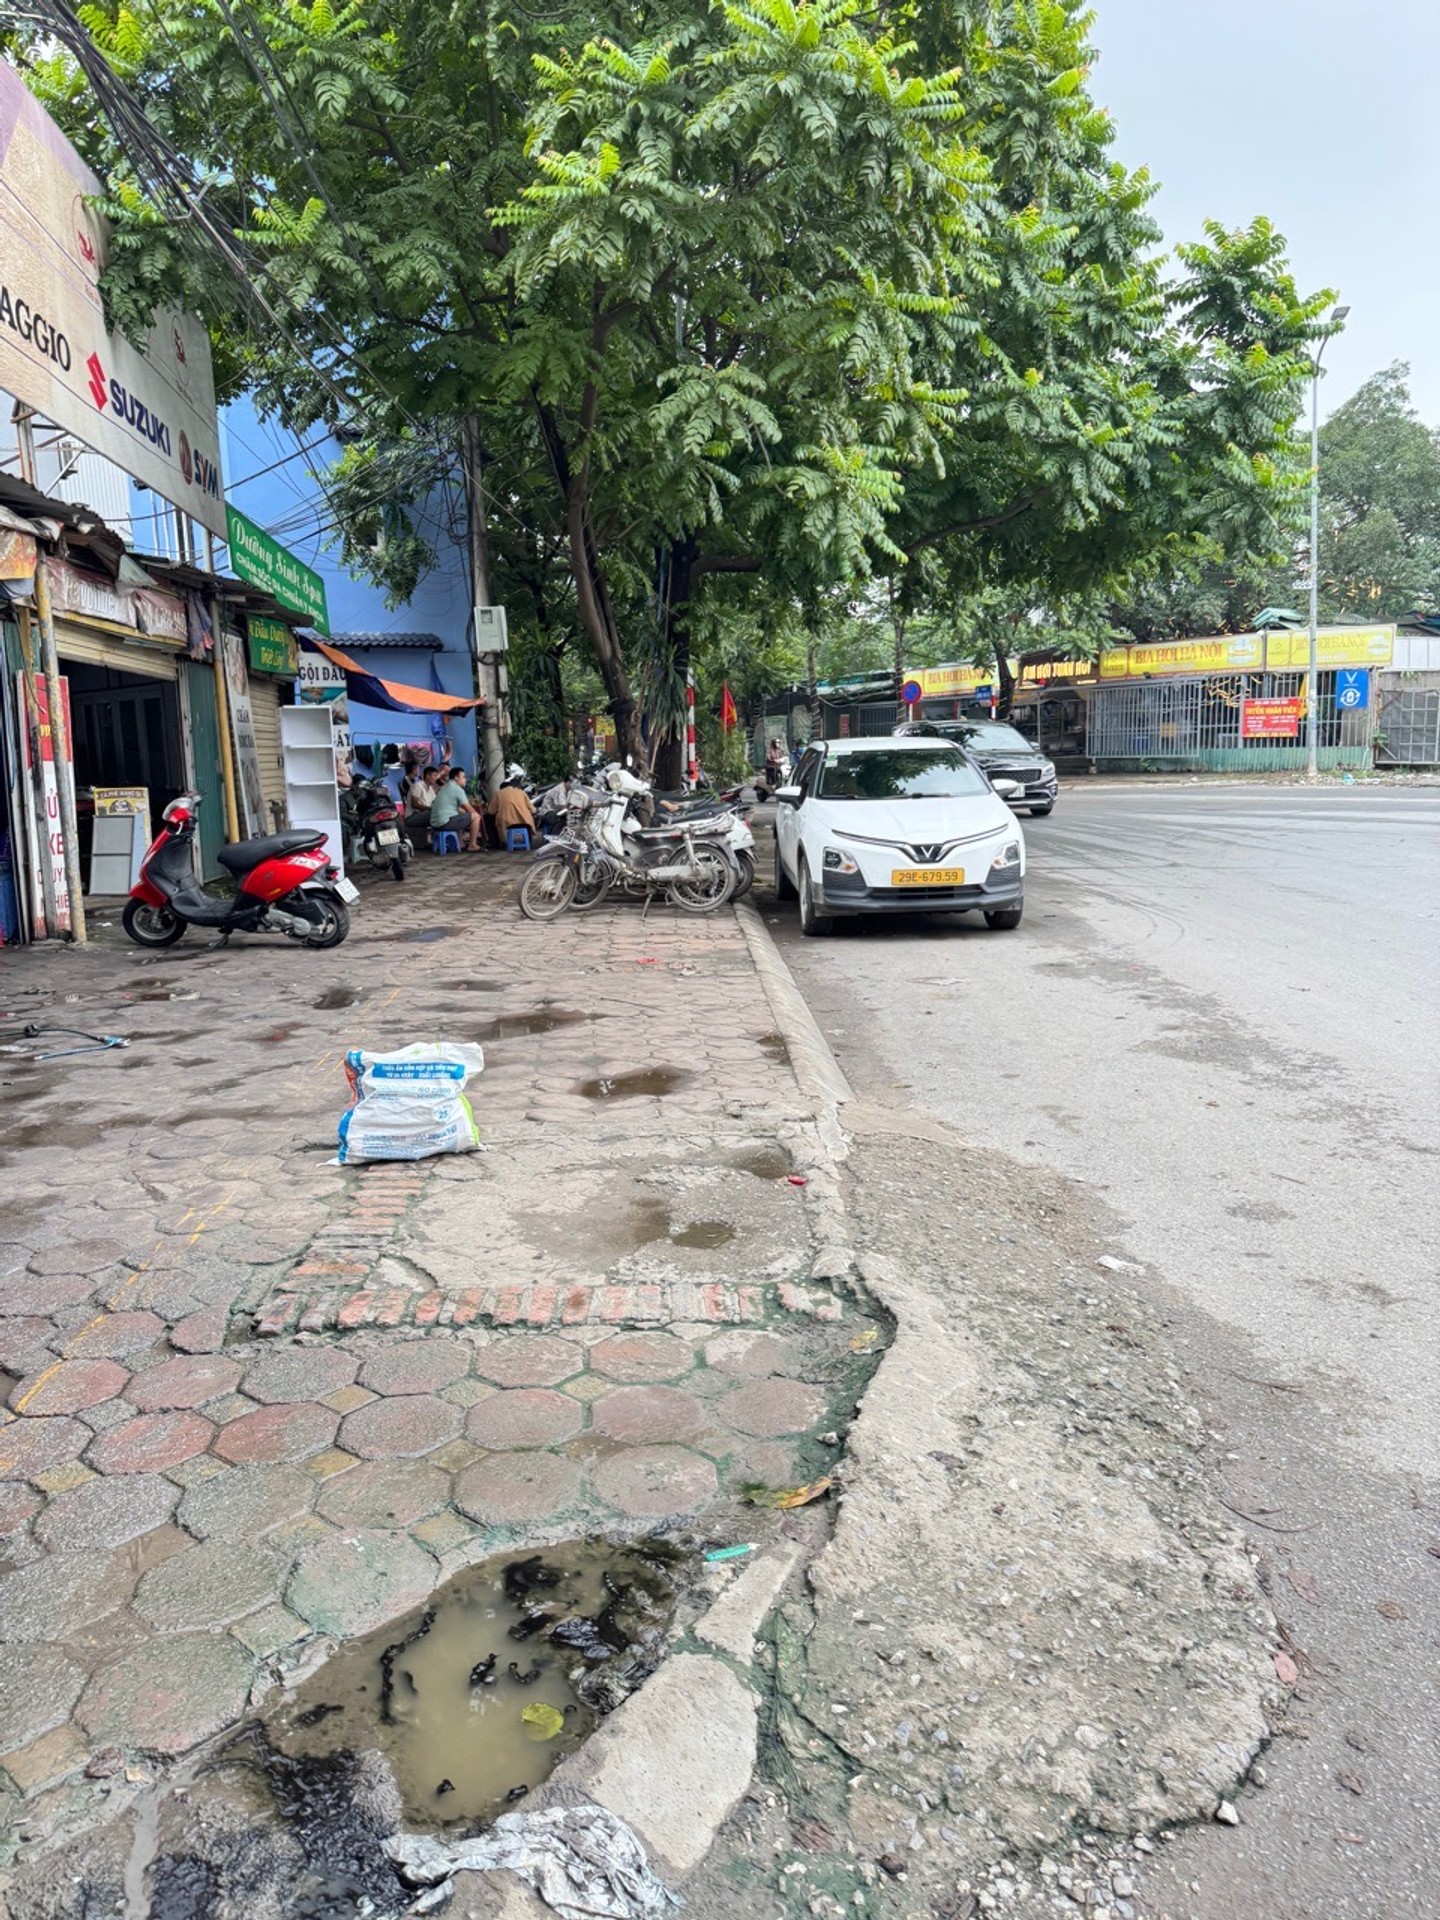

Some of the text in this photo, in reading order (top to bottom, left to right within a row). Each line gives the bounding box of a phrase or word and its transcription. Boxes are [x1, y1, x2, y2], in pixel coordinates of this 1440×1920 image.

[110, 378, 171, 457] SUZUKI
[194, 449, 219, 500] SYM
[231, 518, 273, 572] Dưỡng
[276, 551, 301, 588] Sinh
[302, 573, 322, 605] Spa
[258, 568, 271, 586] SÓC
[1135, 641, 1223, 664] BIA HƠI HÀ NỘI
[299, 662, 320, 685] GỘI
